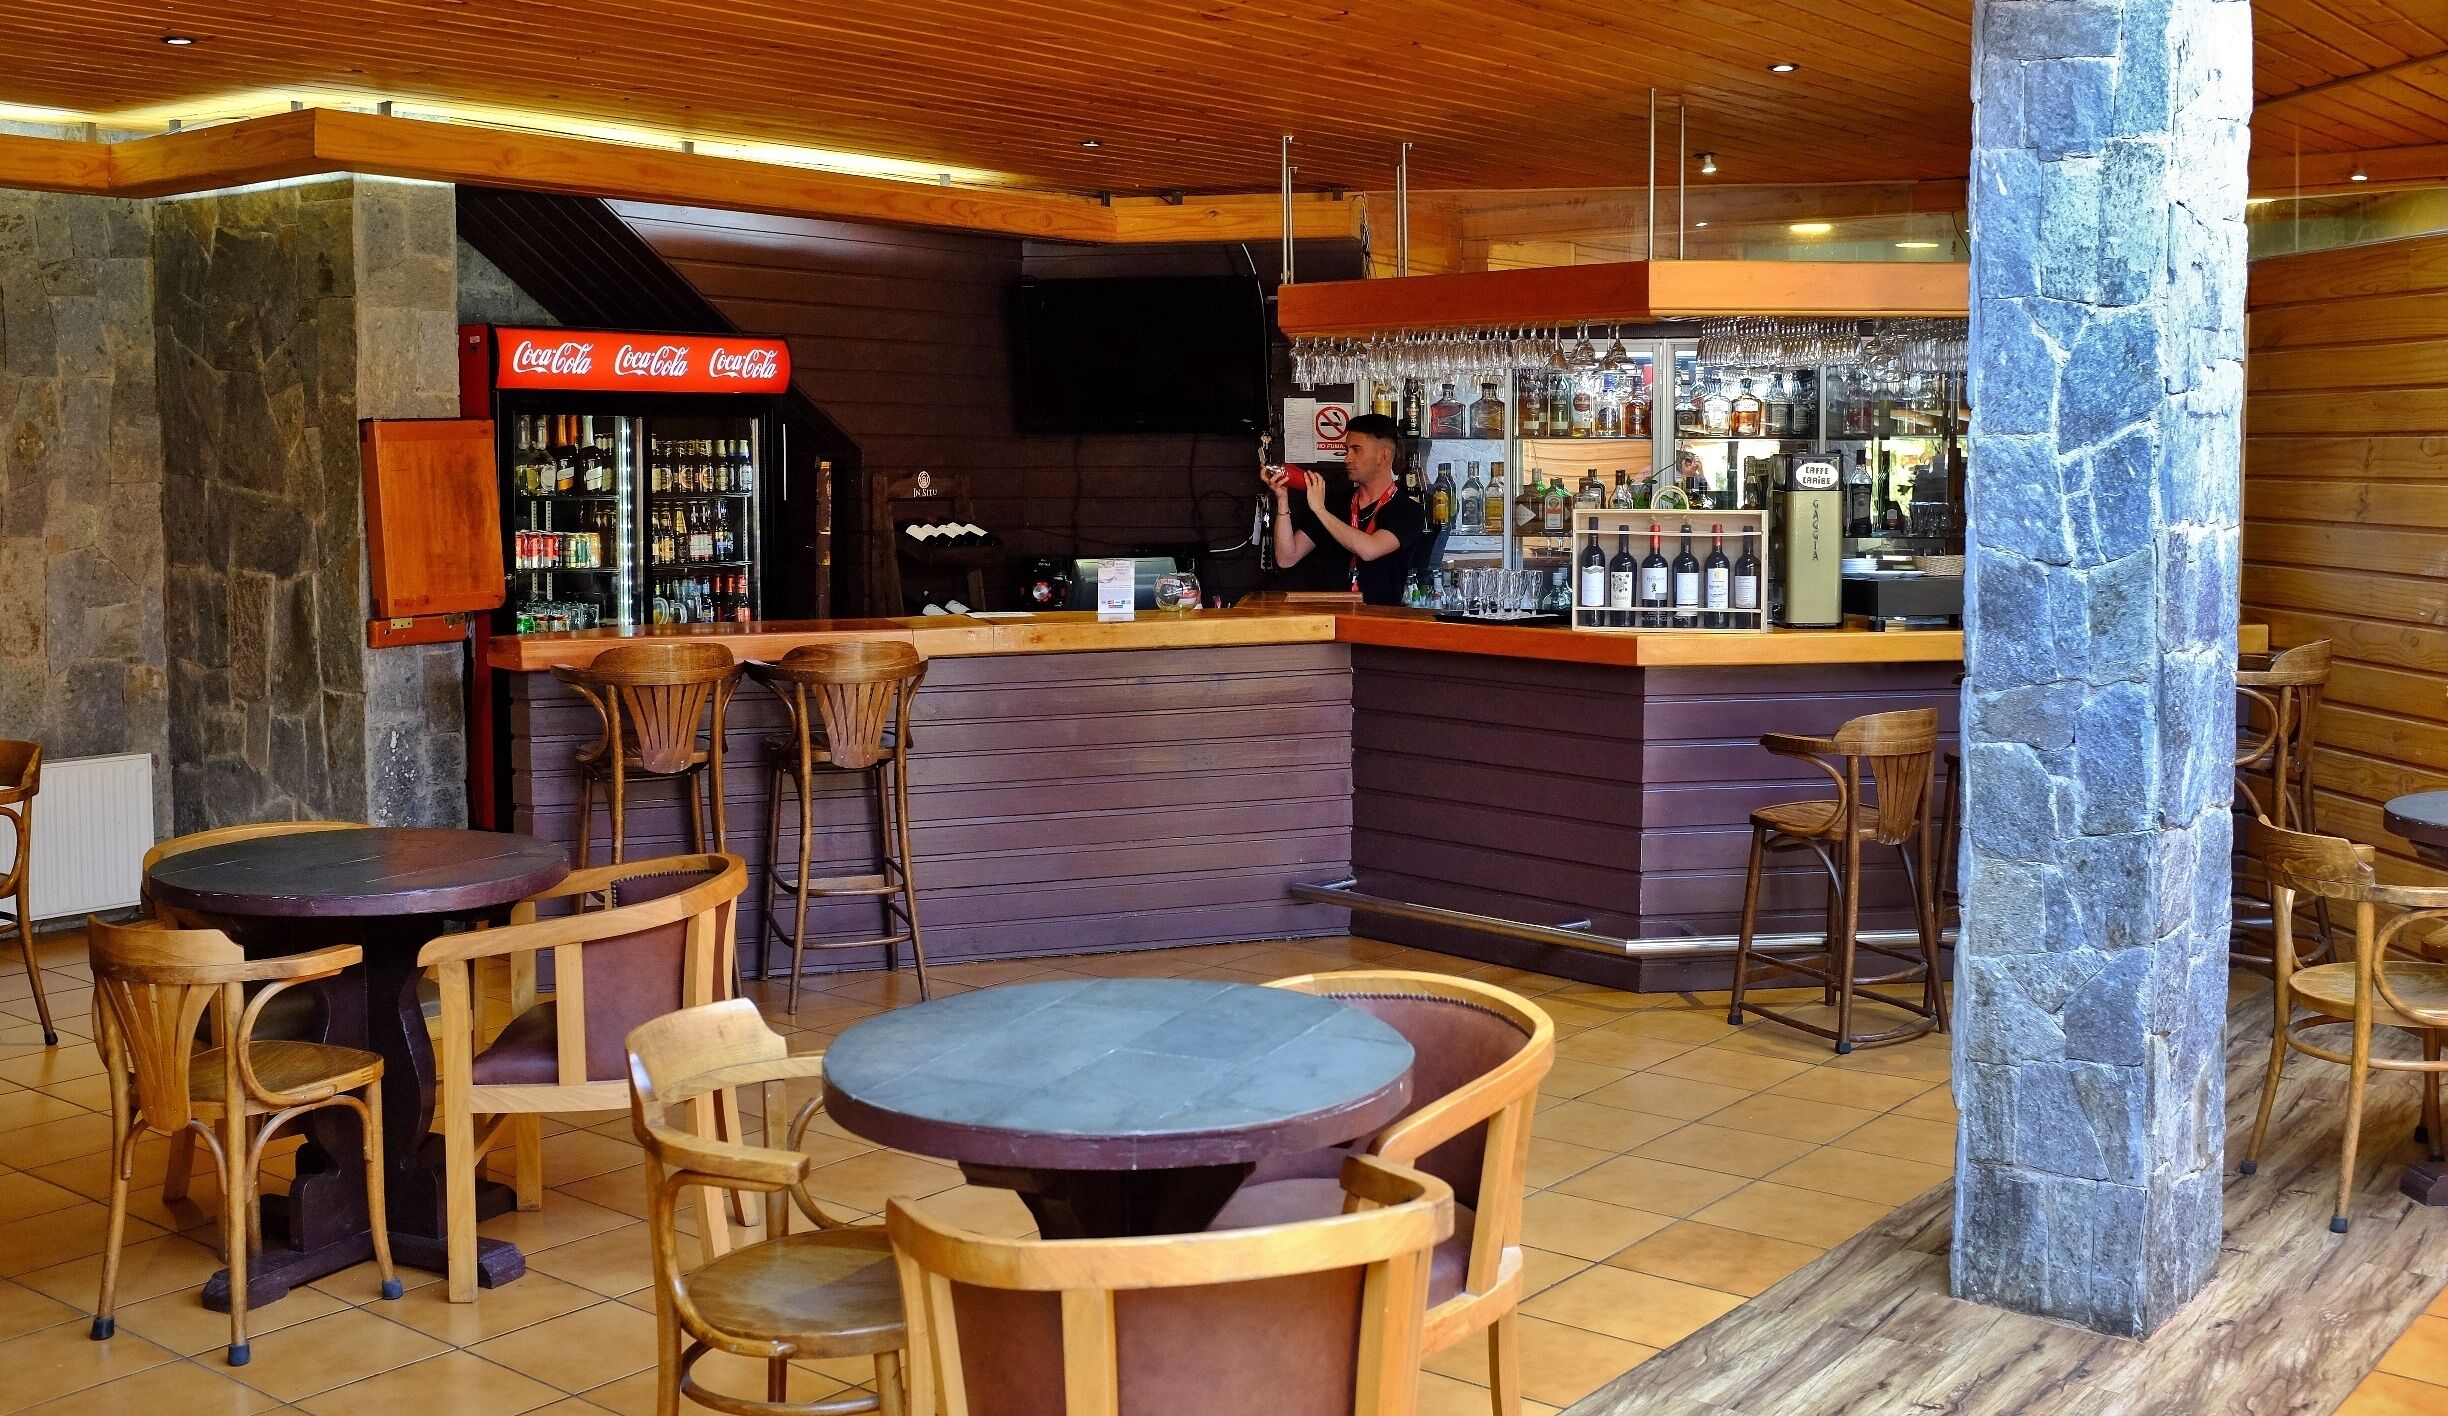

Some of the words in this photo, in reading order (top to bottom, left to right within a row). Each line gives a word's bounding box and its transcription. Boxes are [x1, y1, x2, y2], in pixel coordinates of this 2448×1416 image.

[512, 340, 595, 375] Coca-Cola
[614, 344, 690, 377] Coca-Cola
[708, 347, 779, 379] Coca-Cola
[1805, 466, 1829, 475] CAFFE
[1812, 499, 1820, 561] GAGGIA
